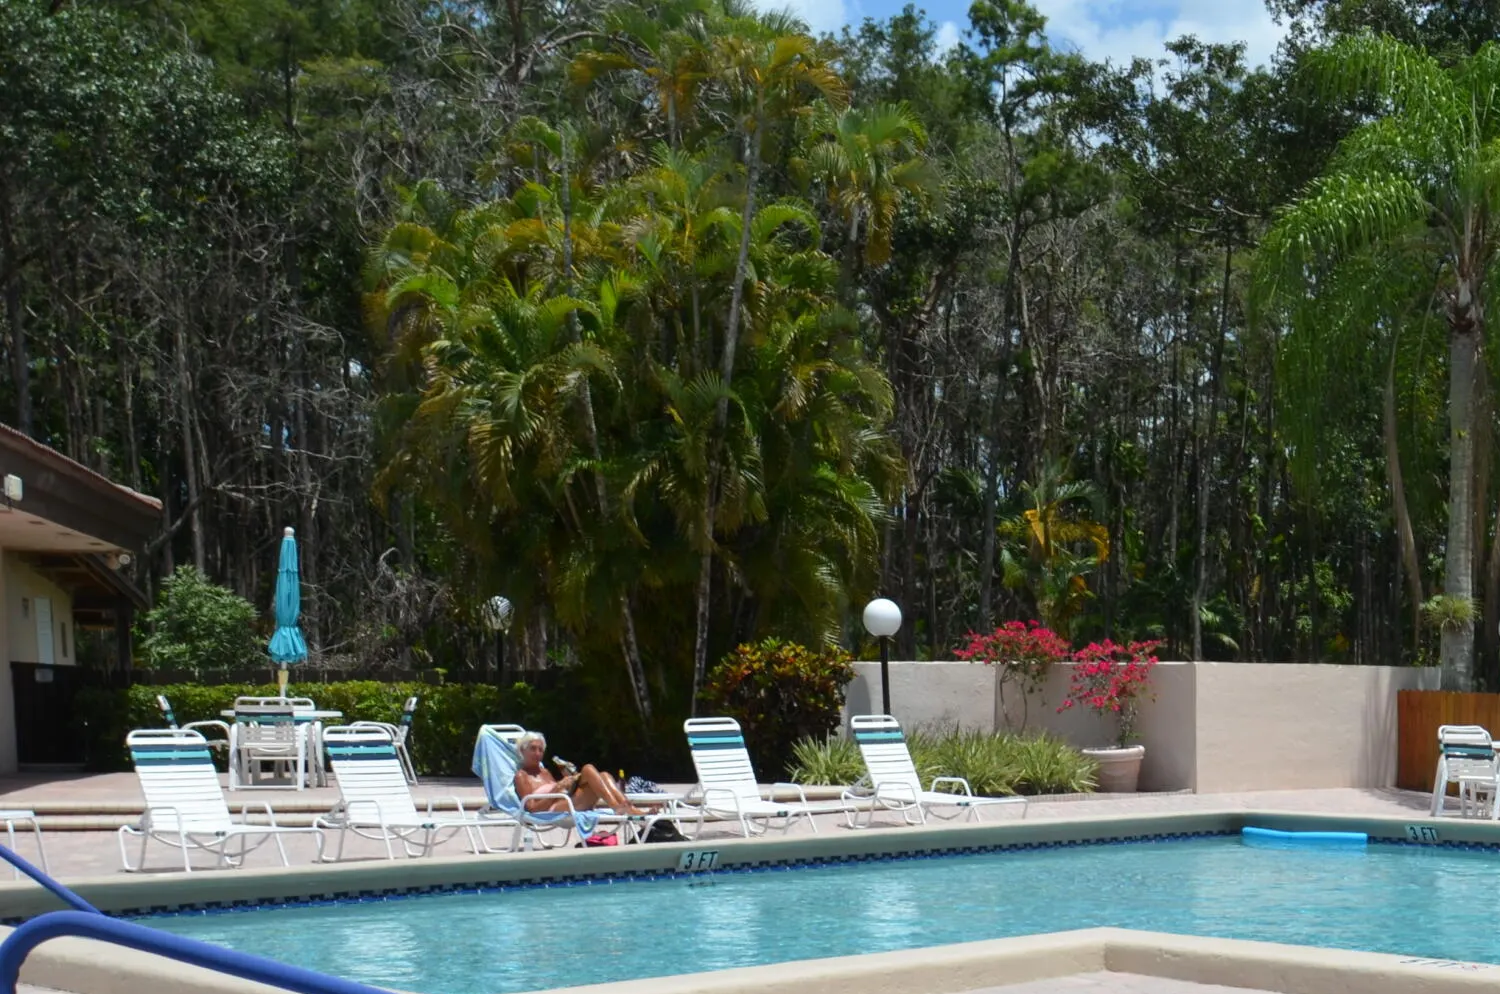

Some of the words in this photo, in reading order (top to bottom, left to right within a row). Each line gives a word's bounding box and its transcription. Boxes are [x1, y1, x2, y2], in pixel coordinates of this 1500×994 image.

[1420, 826, 1436, 841] FT
[684, 852, 695, 869] 3
[698, 850, 718, 869] FT
